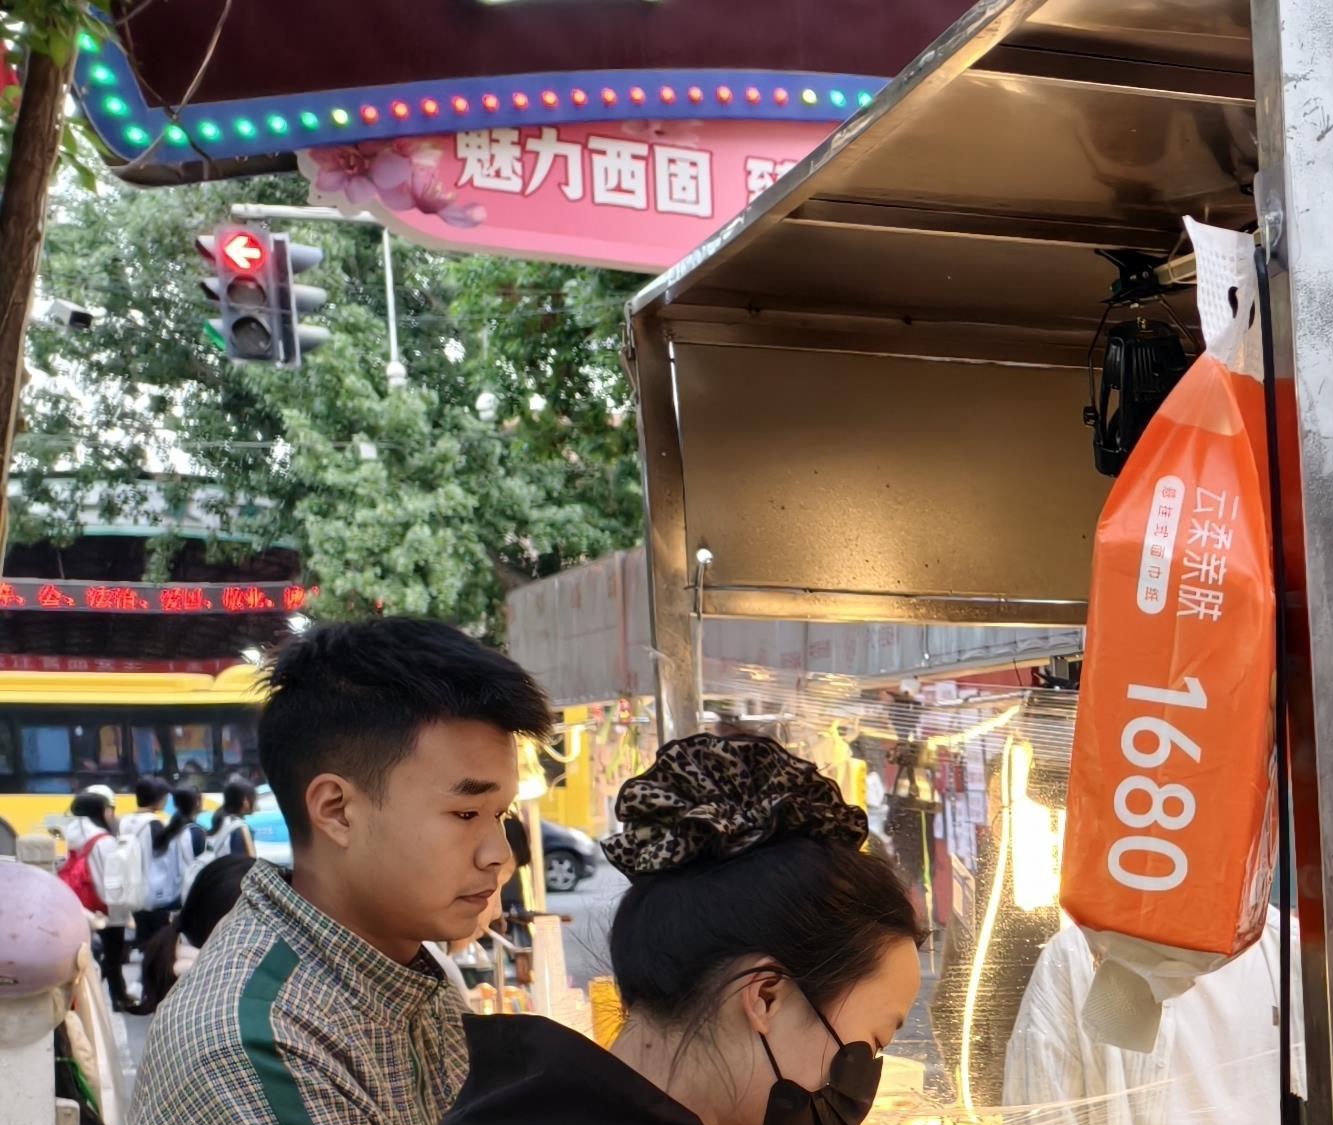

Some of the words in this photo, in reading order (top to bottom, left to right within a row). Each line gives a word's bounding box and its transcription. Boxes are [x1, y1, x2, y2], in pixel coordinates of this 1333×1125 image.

[454, 126, 713, 217] 魅力西固
[1177, 487, 1240, 622] 云柔亲肤
[1107, 676, 1208, 892] 1680
